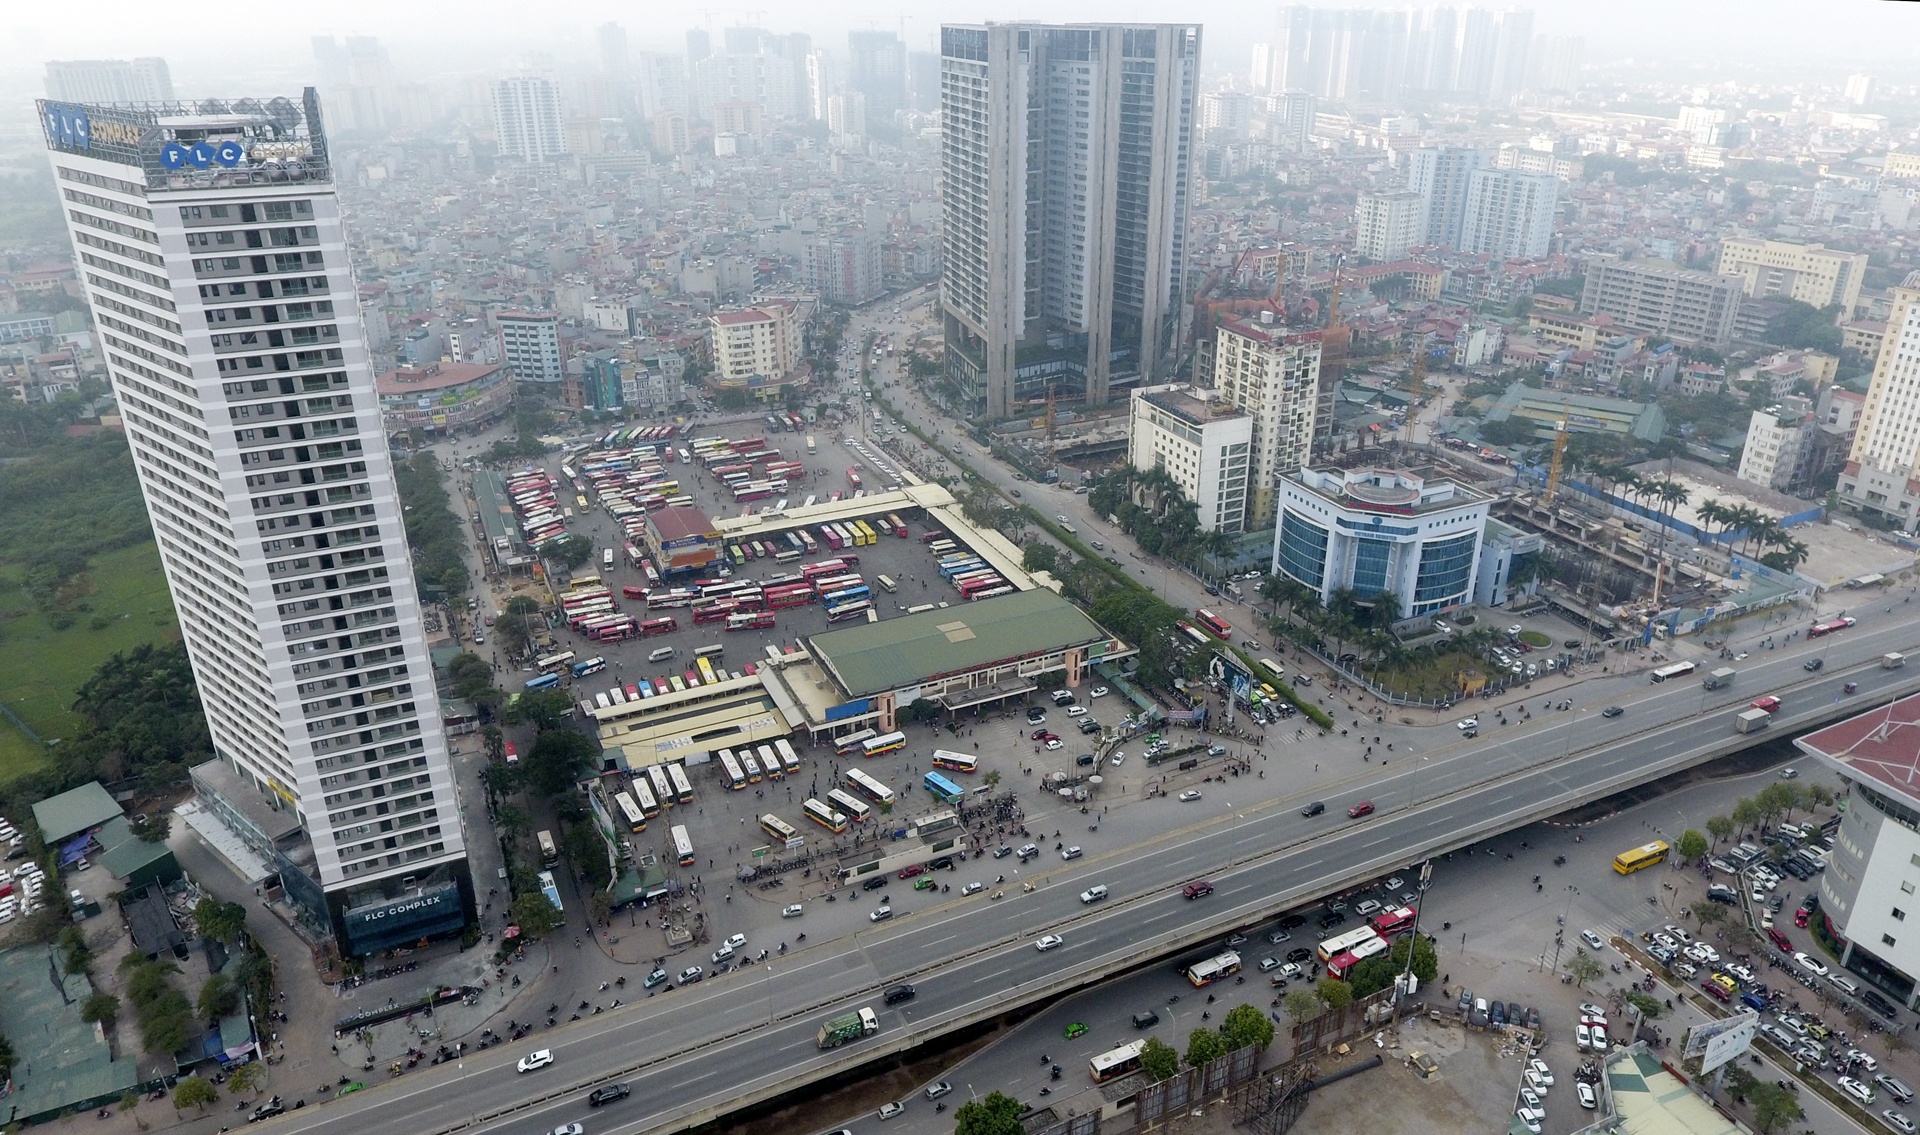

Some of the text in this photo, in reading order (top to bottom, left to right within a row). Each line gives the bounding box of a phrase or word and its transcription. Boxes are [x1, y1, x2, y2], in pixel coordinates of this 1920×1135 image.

[365, 896, 440, 922] FLC COMPLEX
[358, 1002, 400, 1019] COMPLEX
